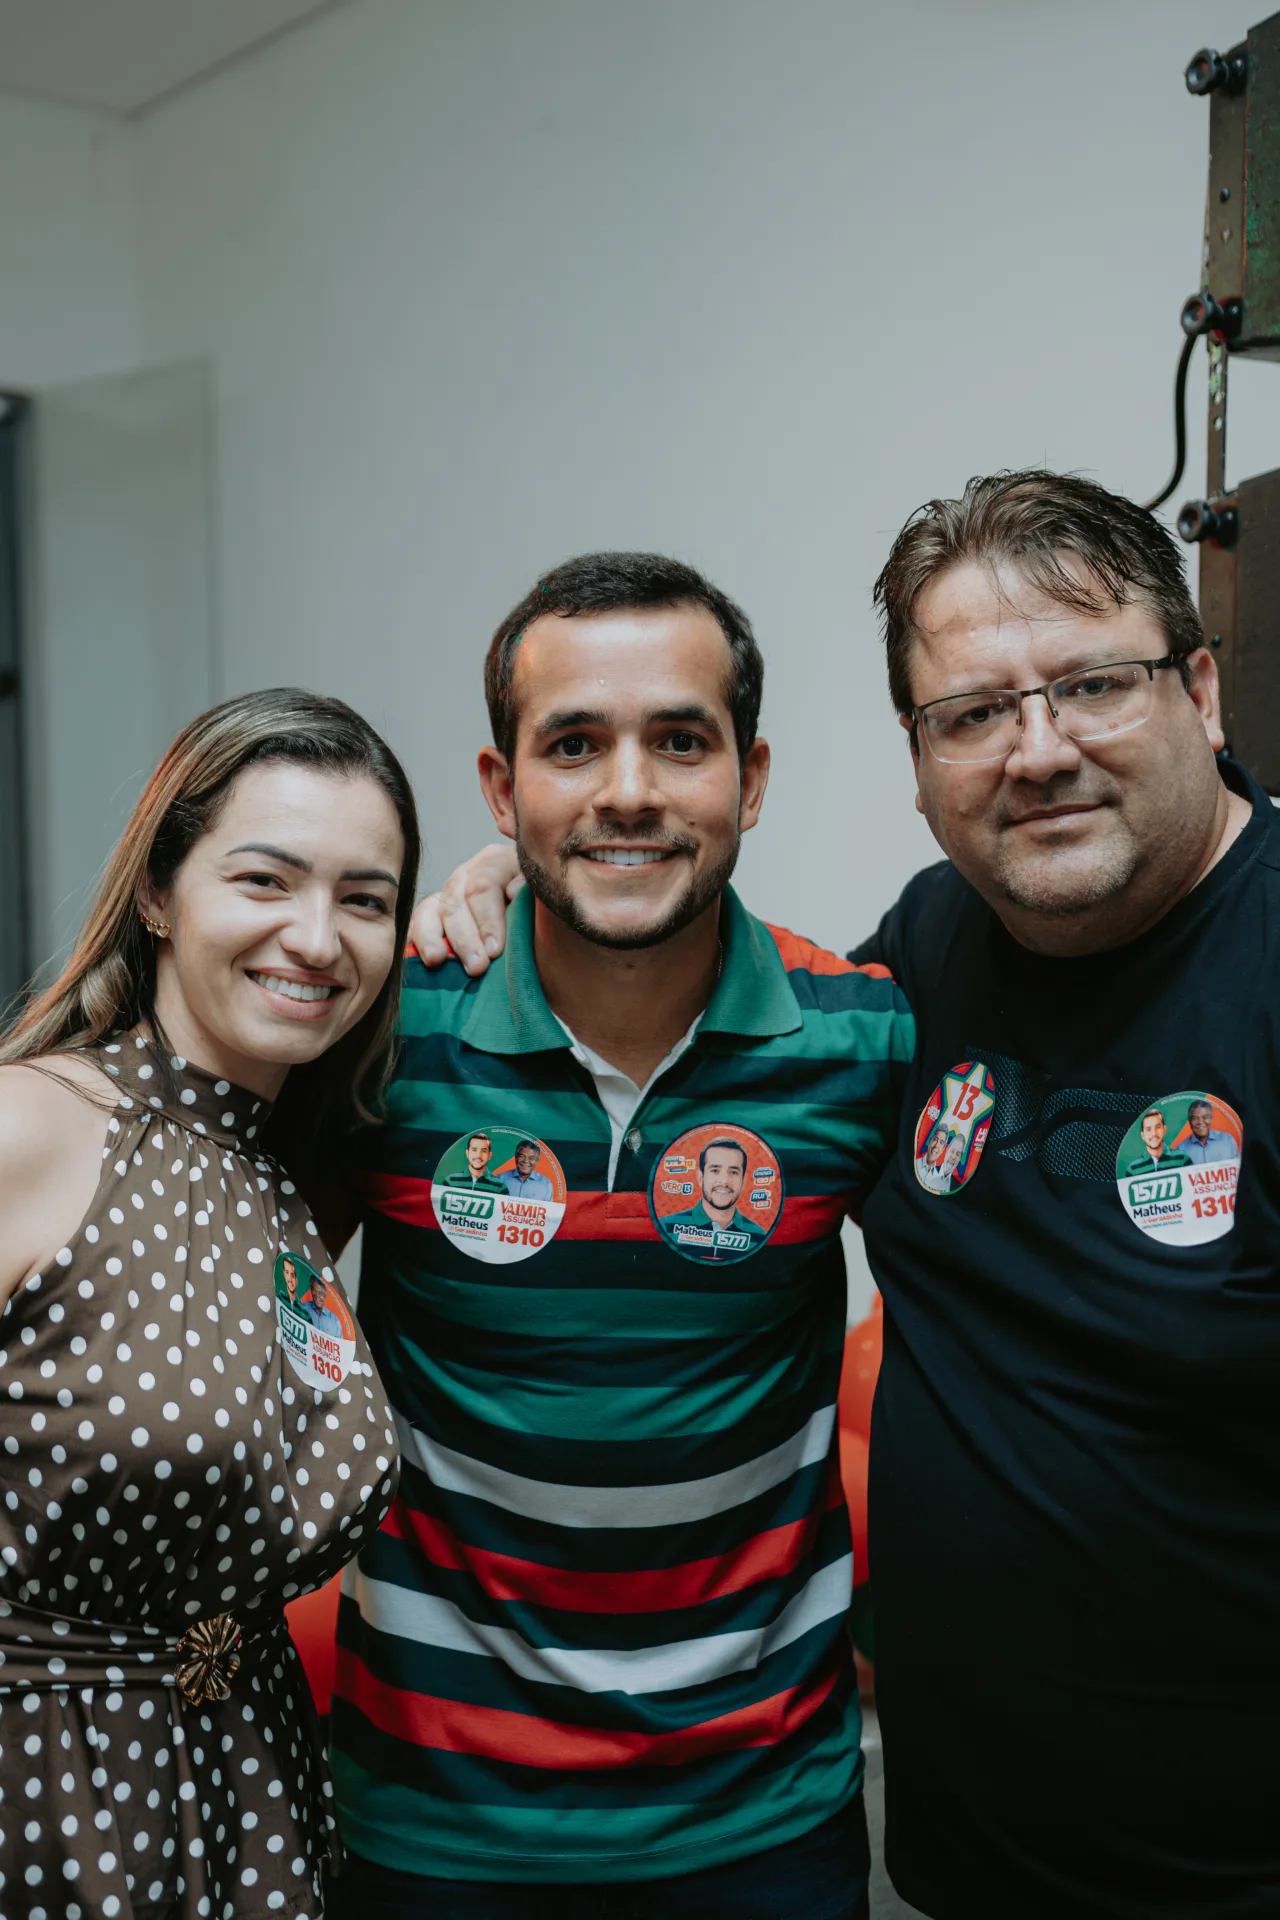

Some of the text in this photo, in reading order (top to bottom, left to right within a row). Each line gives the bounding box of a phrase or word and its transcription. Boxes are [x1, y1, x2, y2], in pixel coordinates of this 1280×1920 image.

[952, 1081, 980, 1120] 13
[1188, 1166, 1237, 1187] VALMIR
[1131, 1176, 1178, 1203] 15777
[444, 1193, 491, 1216] 15777
[501, 1201, 547, 1220] VALMIR
[1133, 1203, 1182, 1219] Matheus
[441, 1214, 488, 1231] Matheus
[496, 1224, 545, 1248] 1310
[674, 1224, 713, 1238] Matheus
[716, 1232, 748, 1248] 15777
[311, 1353, 342, 1383] 1310
